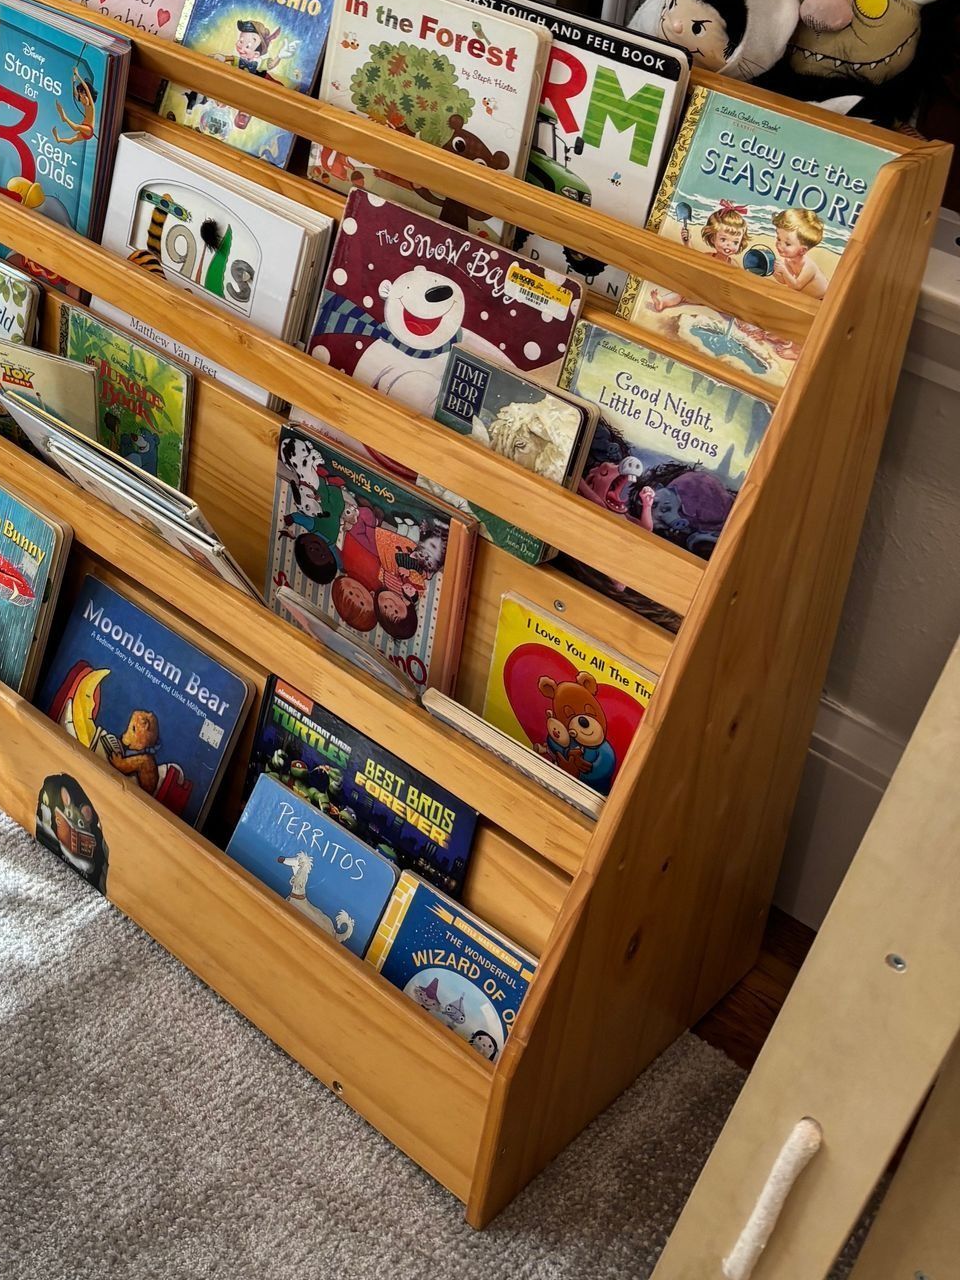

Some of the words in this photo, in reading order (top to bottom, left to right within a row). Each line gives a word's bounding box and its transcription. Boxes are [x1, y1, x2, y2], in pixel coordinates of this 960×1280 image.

[22, 41, 46, 65] Disney
[376, 5, 413, 34] the
[419, 14, 518, 72] Forest
[500, 3, 547, 27] TOUCH
[551, 22, 582, 41] AND
[586, 34, 616, 54] FEEL
[621, 46, 667, 71] BOOK
[4, 52, 63, 96] Stories
[24, 83, 39, 99] for
[461, 67, 471, 81] by
[472, 70, 492, 85] Steph
[540, 45, 665, 167] RM
[738, 111, 761, 127] Golden
[31, 132, 78, 167] -Year-
[36, 155, 75, 190] Olds
[719, 129, 735, 147] a
[739, 135, 786, 169] day
[790, 154, 819, 176] at
[824, 164, 868, 194] the
[700, 147, 865, 229] SEASHORE
[376, 230, 399, 247] The
[399, 224, 470, 264] Snow
[0, 363, 36, 381] TOY
[129, 317, 169, 348] Matthew
[172, 342, 191, 362] Van
[193, 356, 217, 378] Fleet
[618, 348, 640, 364] Golden
[2, 372, 33, 389] STORY
[97, 358, 165, 411] JUNGLE
[450, 381, 479, 404] FOR
[455, 360, 488, 390] TIME
[446, 396, 475, 419] BED
[598, 386, 642, 420] Little
[645, 408, 719, 457] Dragons
[616, 371, 661, 407] Good
[664, 392, 714, 433] Night,
[331, 459, 372, 493] Fujikawa
[373, 484, 396, 504] Gyo
[3, 517, 47, 566] Bunny
[83, 600, 182, 684] Moonbeam
[184, 671, 230, 717] Bear
[96, 634, 115, 652] Bedtime
[115, 648, 127, 662] Story
[128, 657, 134, 666] by
[135, 663, 145, 674] Rolf
[161, 682, 171, 692] and
[526, 618, 532, 629] I
[535, 623, 562, 647] Love
[565, 640, 587, 662] You
[589, 656, 605, 672] All
[608, 665, 630, 687] The
[634, 680, 654, 700] Tim
[272, 703, 351, 768] TURTLES
[274, 696, 302, 719] TEENAGE
[301, 715, 331, 739] MUTANT
[330, 734, 352, 753] NINJA
[354, 771, 451, 850] FOREVER
[364, 758, 405, 795] BEST
[405, 785, 456, 834] BROS
[278, 800, 367, 882] PERRITOS
[412, 949, 481, 979] WIZARD
[483, 978, 506, 1002] OF
[445, 931, 463, 948] THE
[464, 944, 518, 989] WONDERFUL
